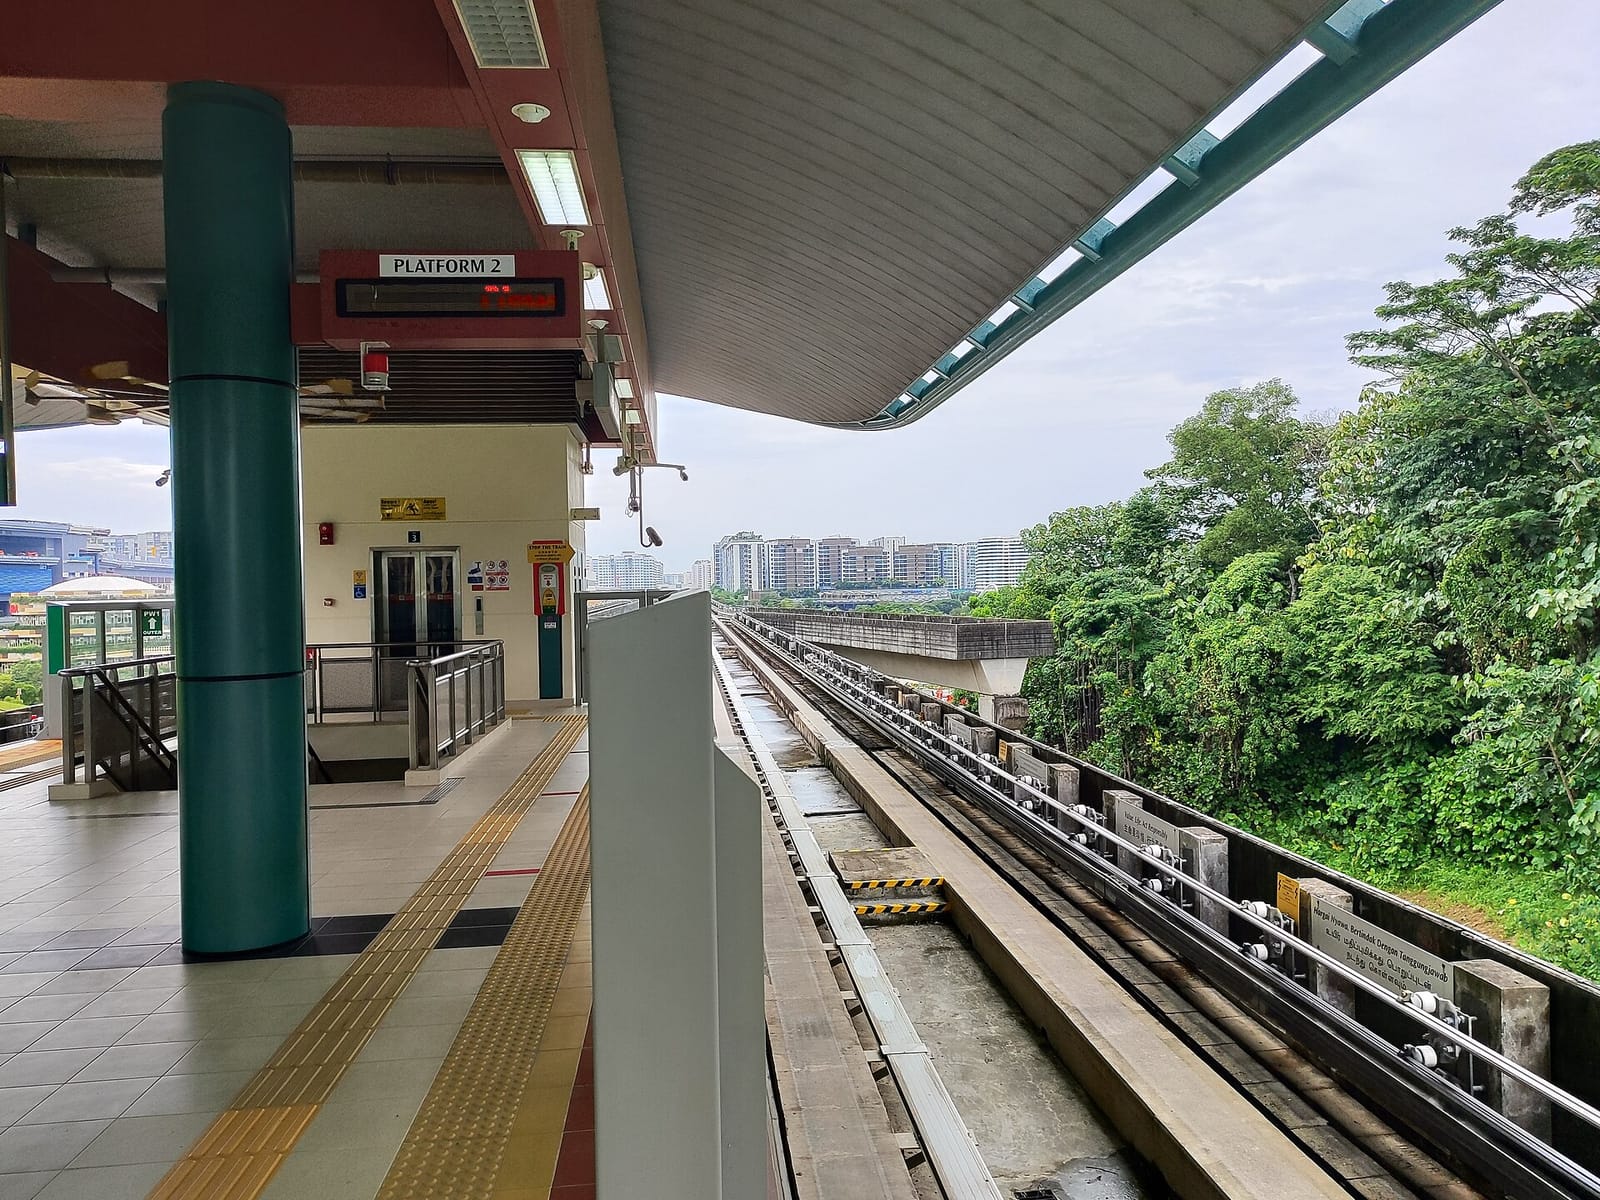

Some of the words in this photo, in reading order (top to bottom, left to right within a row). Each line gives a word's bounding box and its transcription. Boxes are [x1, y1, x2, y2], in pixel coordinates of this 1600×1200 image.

[394, 259, 485, 273] PLATFORM
[490, 259, 501, 273] 2
[411, 534, 417, 542] 3
[1313, 906, 1330, 920] Hargai
[1350, 924, 1376, 944] Bertindak
[1376, 938, 1399, 957] Dengan
[1399, 950, 1449, 983] Tanggungjawab
